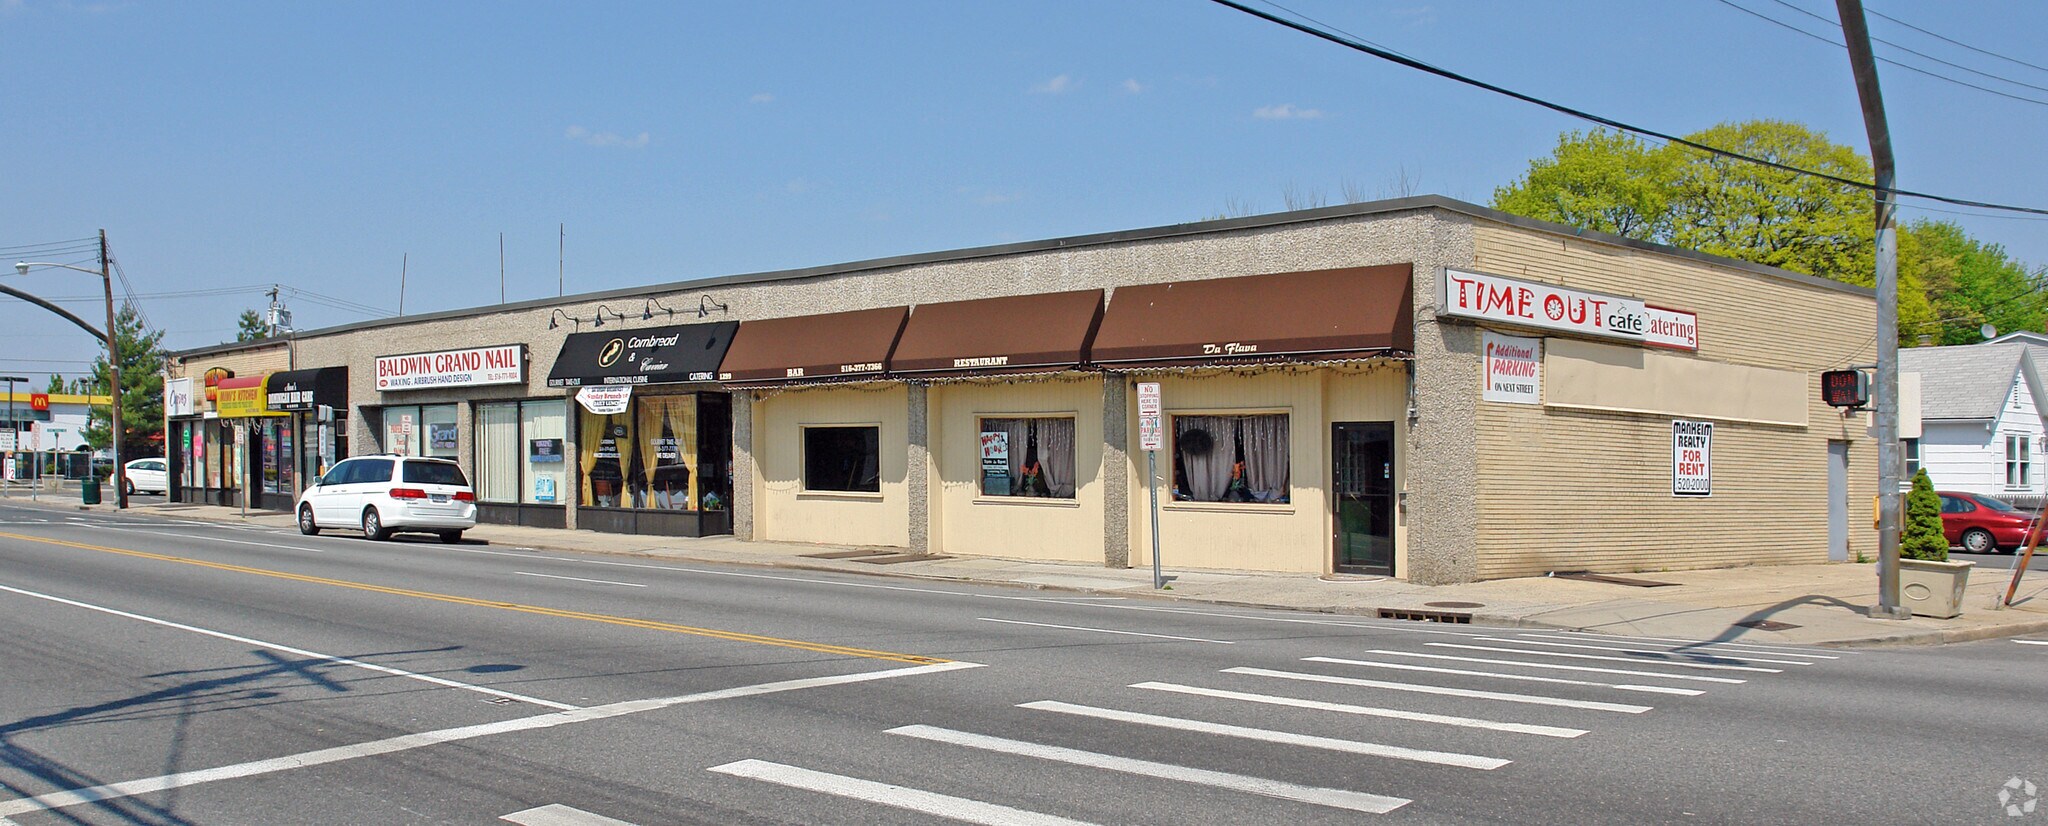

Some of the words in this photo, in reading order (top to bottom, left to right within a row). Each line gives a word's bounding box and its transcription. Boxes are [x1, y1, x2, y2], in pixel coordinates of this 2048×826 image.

[1451, 274, 1535, 320] TIME
[1544, 293, 1608, 328] OUT
[1608, 312, 1643, 331] café
[1202, 343, 1221, 355] Da
[1224, 342, 1258, 356] Flava
[1495, 344, 1534, 359] Additional
[379, 355, 431, 378] BALDWIN
[435, 351, 481, 374] GRAND
[485, 348, 517, 370] NAIL
[628, 352, 636, 362] &
[953, 356, 1008, 368] RESTAURANT
[786, 367, 804, 378] BAR
[1492, 358, 1536, 378] PARKING
[390, 377, 411, 387] WAXING
[437, 374, 453, 384] HAND
[453, 373, 473, 383] DESIGN
[688, 371, 714, 382] CATERING
[1831, 373, 1857, 388] DON
[1494, 382, 1502, 392] ON
[1503, 382, 1516, 393] NEXT
[1516, 383, 1534, 394] STREET
[1831, 389, 1858, 403] WAL
[1678, 435, 1706, 448] REALTY
[1683, 449, 1701, 462] FOR
[1679, 462, 1705, 476] RENT
[1677, 477, 1709, 491] 520-2000
